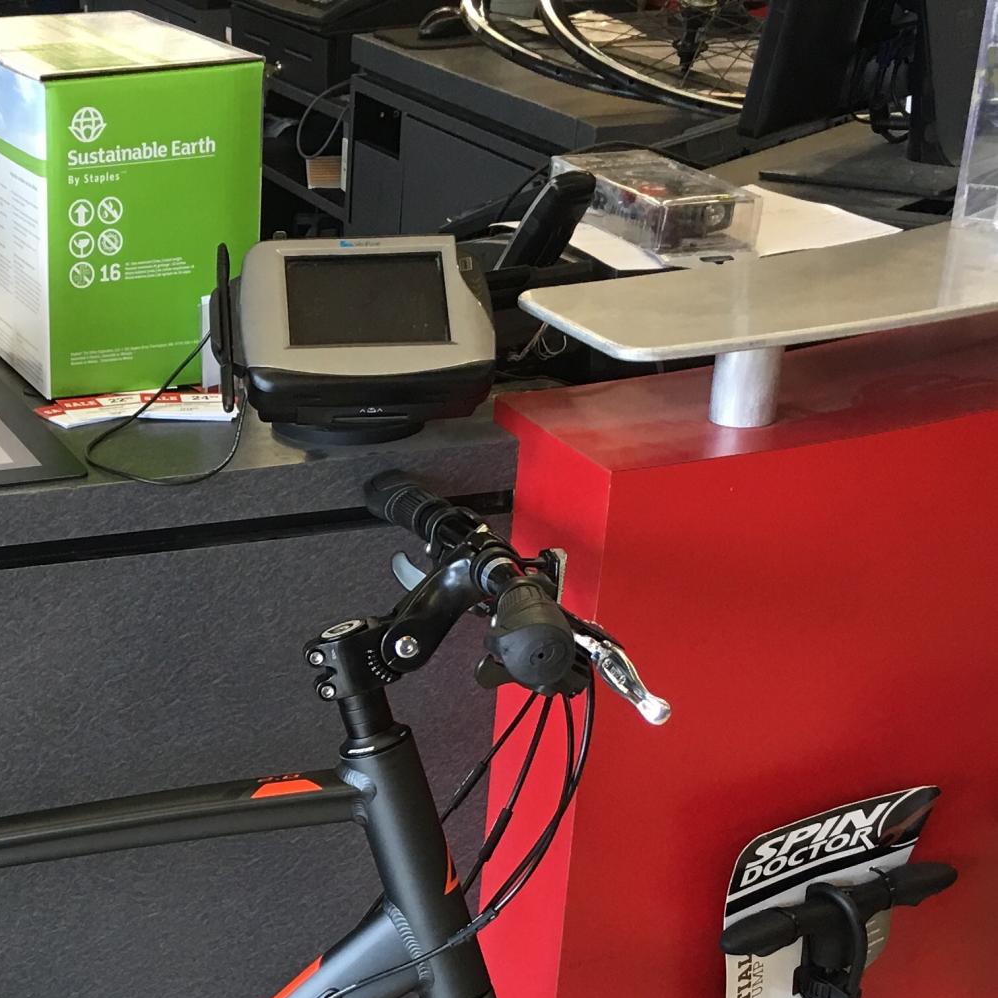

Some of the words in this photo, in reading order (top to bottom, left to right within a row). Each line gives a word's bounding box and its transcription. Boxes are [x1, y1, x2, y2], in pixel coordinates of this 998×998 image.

[67, 141, 168, 167] Sustainable
[171, 136, 216, 157] Earth
[68, 175, 80, 187] By
[83, 171, 121, 185] Staples
[99, 263, 121, 282] 16
[746, 801, 891, 869] SPIN
[739, 826, 880, 888] DOCTOR
